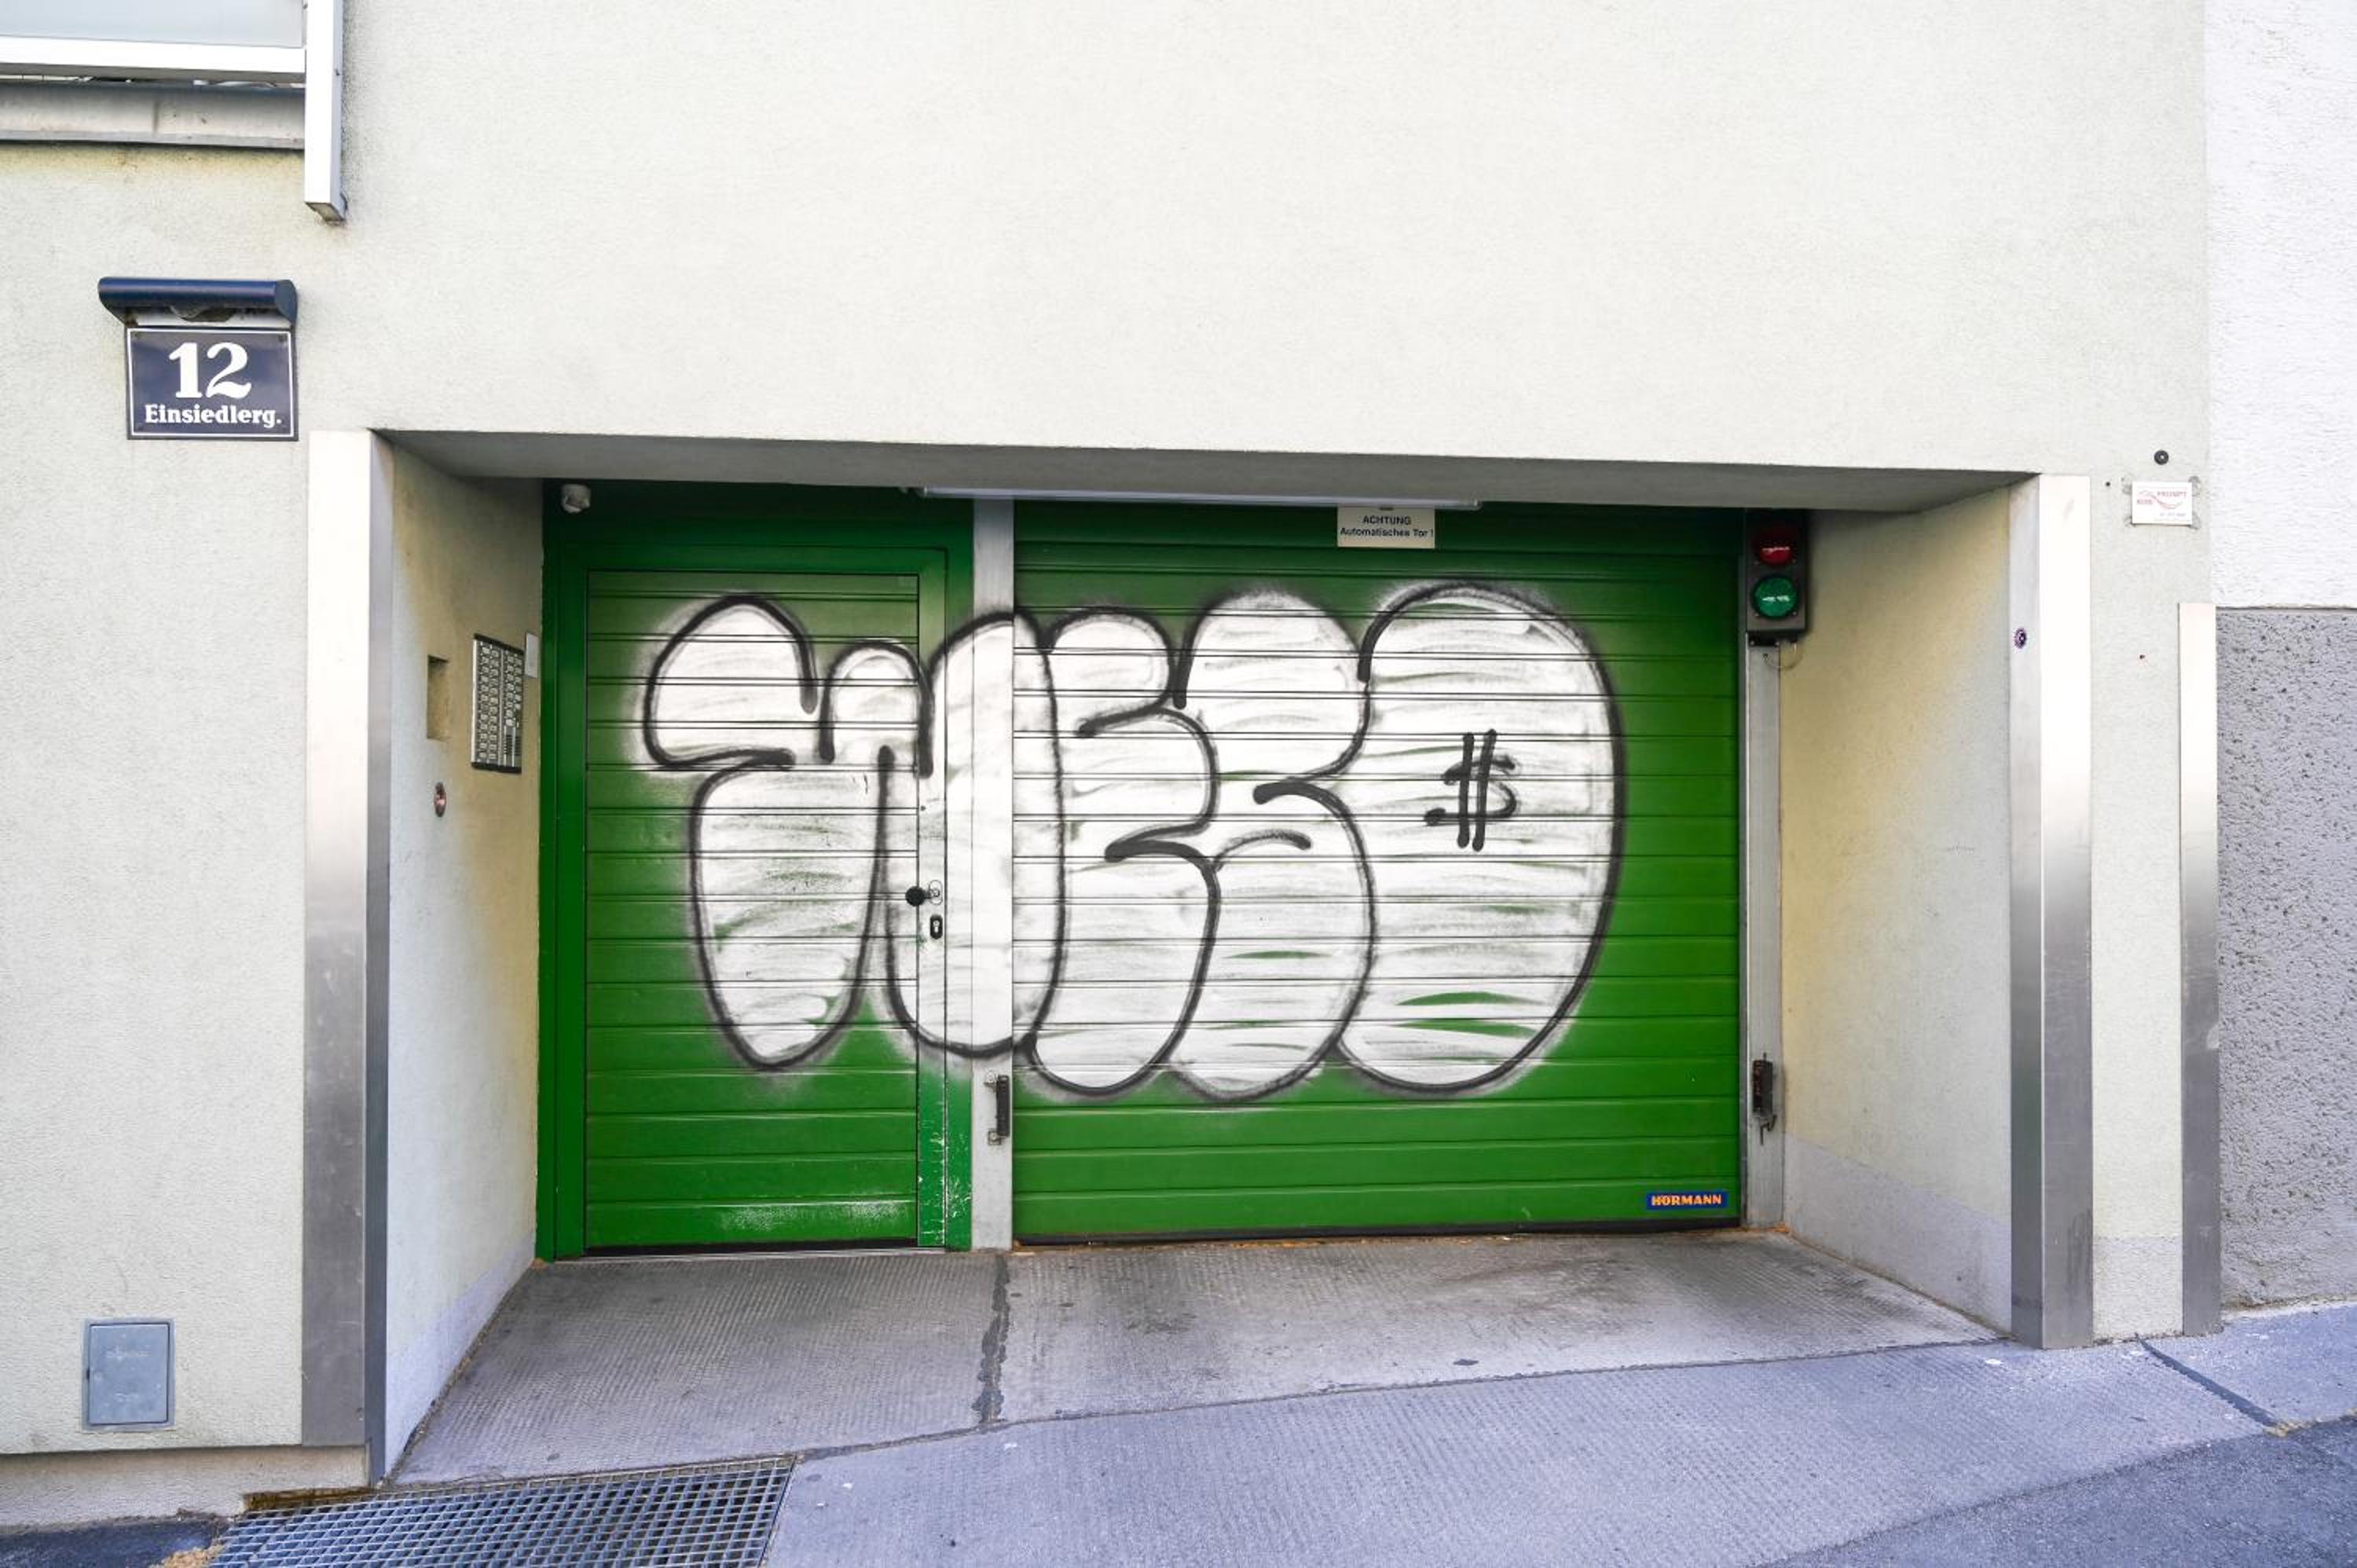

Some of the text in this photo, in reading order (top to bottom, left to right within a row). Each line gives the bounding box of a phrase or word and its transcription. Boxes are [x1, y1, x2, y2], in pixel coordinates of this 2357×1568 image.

[169, 342, 251, 398] 12
[145, 404, 282, 428] Einsiedlerg.
[1363, 515, 1412, 525] ACHTUNG
[1340, 527, 1410, 537] Automatisches
